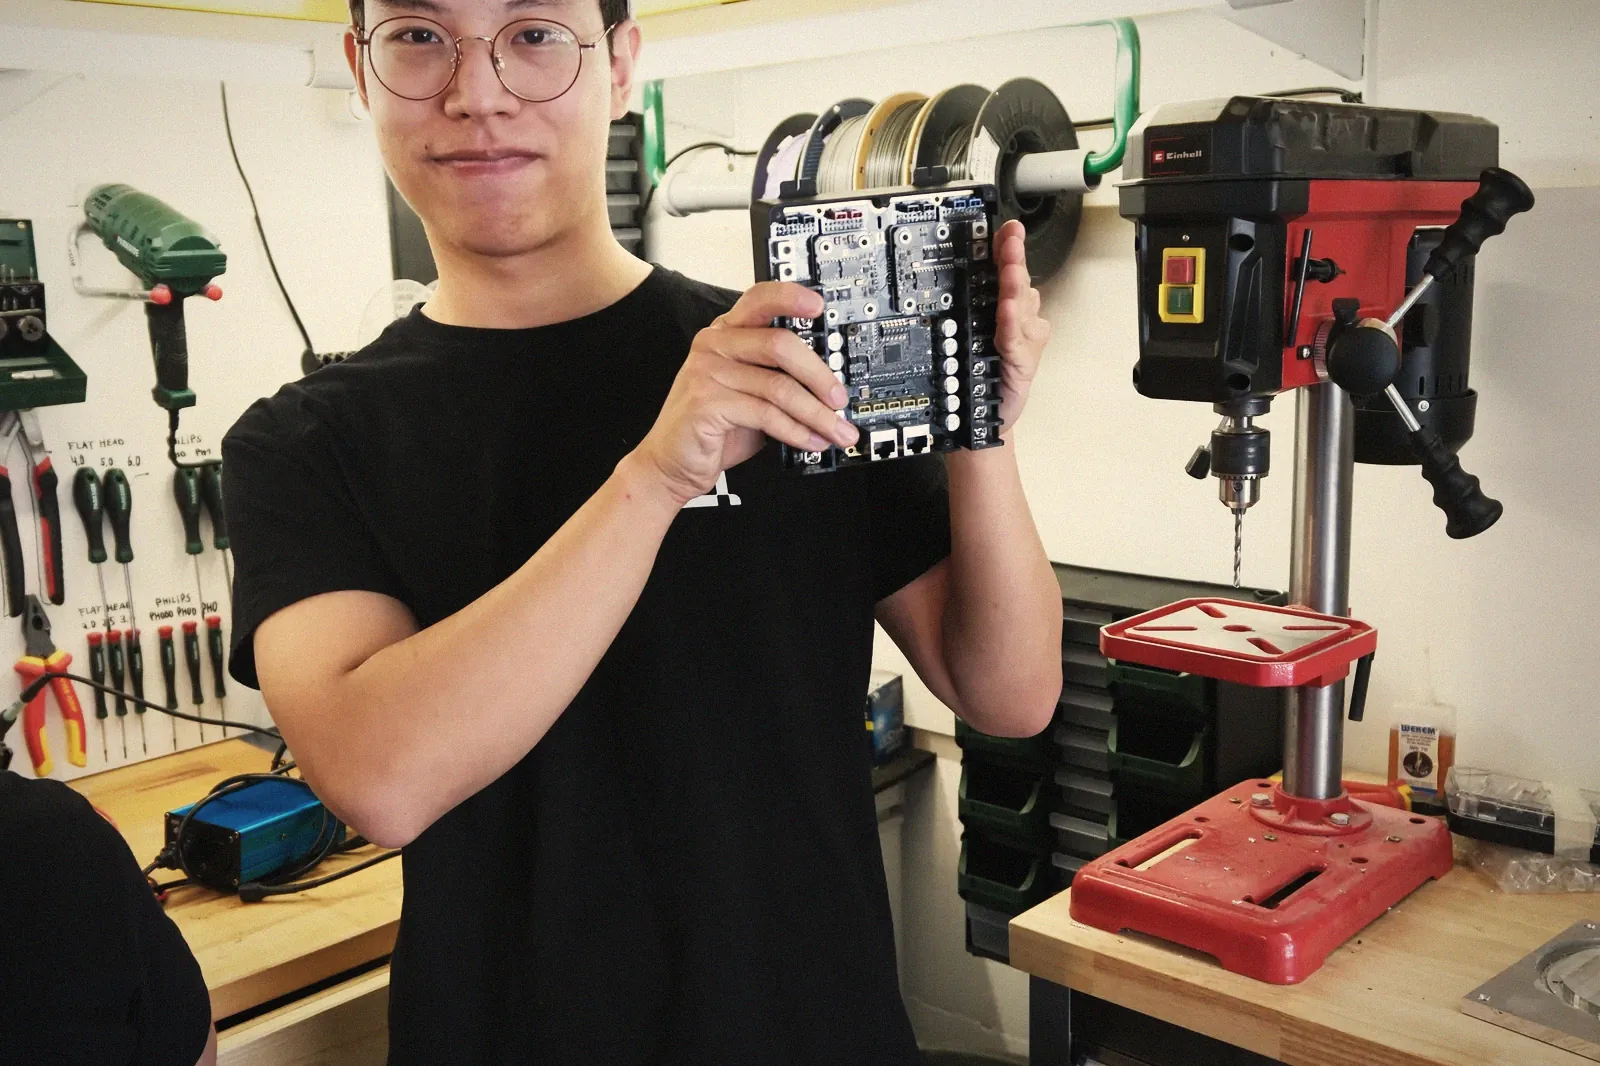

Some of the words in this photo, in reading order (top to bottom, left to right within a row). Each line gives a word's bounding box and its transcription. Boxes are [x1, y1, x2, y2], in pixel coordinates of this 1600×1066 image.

[1166, 150, 1202, 159] Einhell
[67, 441, 93, 450] FLAT
[100, 439, 124, 447] HEAD
[71, 455, 85, 466] 4.0
[100, 457, 114, 466] 5.0
[127, 455, 141, 466] 6.0
[155, 593, 191, 607] PHILIPS
[78, 605, 101, 616] FLAT
[1401, 724, 1435, 735] WEKEM
